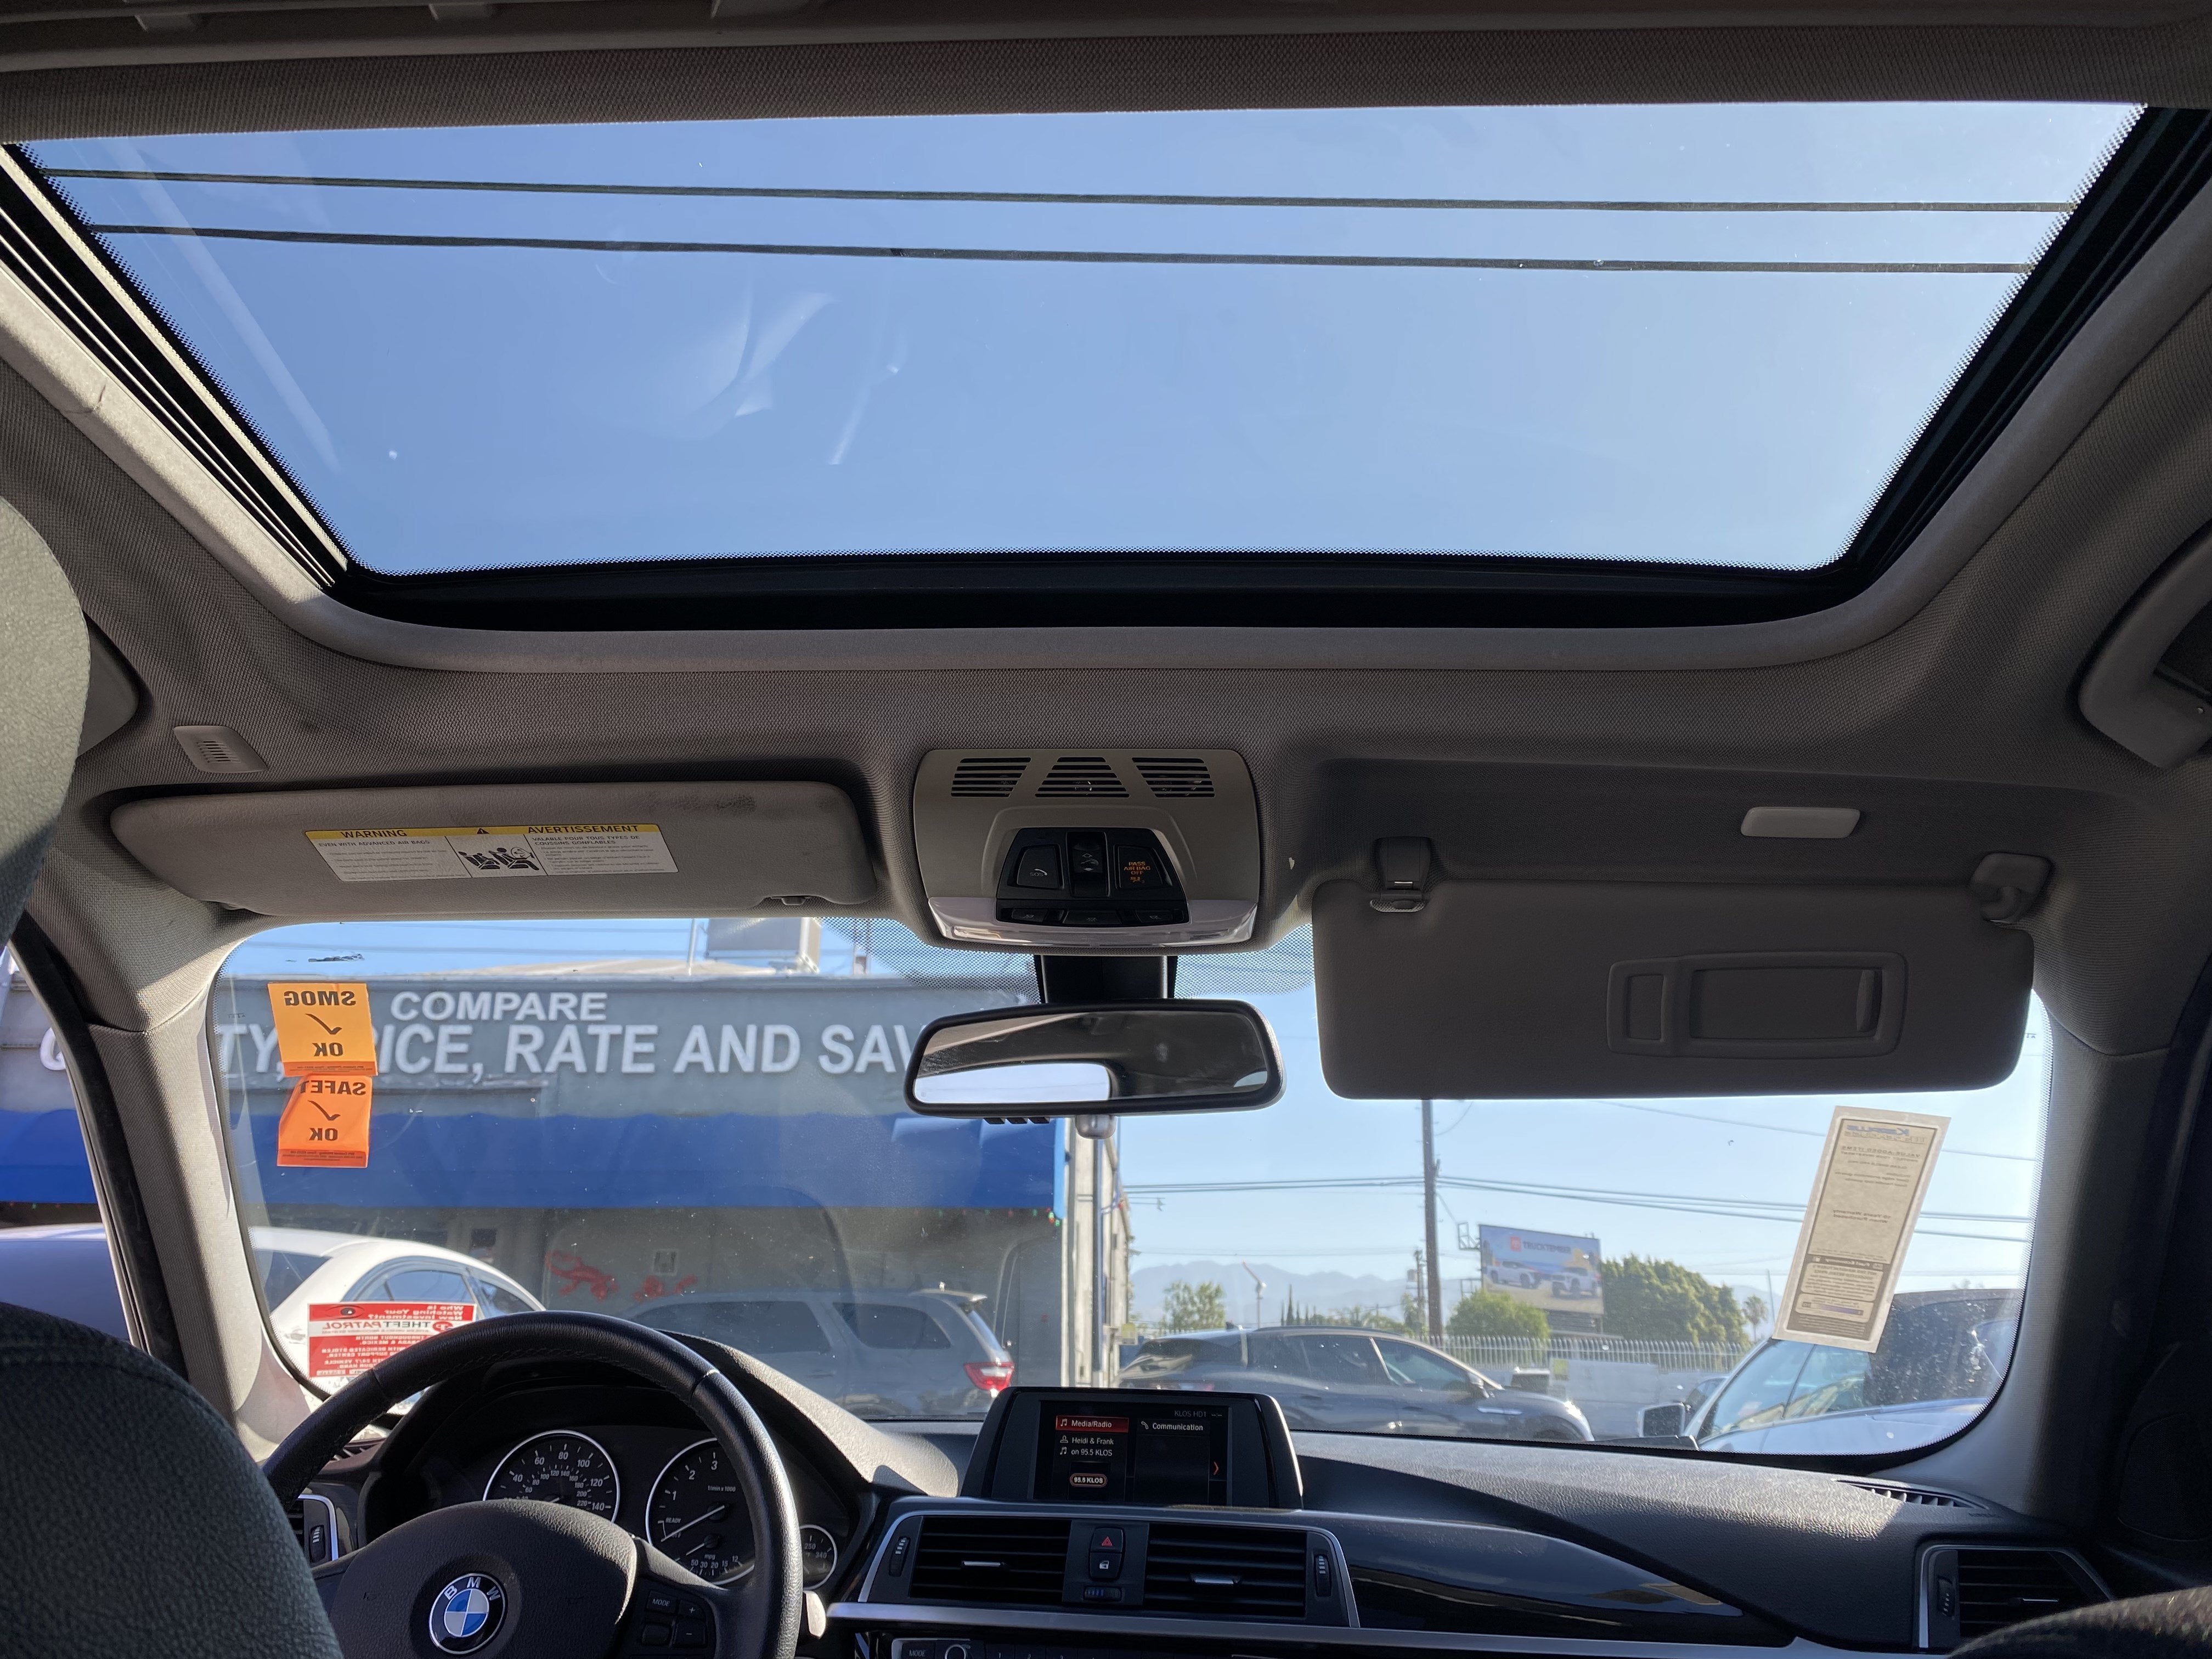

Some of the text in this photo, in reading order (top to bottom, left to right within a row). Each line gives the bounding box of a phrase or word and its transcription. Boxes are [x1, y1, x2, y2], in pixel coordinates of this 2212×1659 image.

[528, 825, 639, 833] AVERTISSEMENT
[341, 830, 407, 838] WARNING
[391, 991, 608, 1022] COMPARE
[503, 1024, 659, 1074] RATE
[673, 1024, 802, 1074] AND
[817, 1023, 927, 1075] SAV
[1152, 1423, 1203, 1431] Communication
[558, 1452, 569, 1460] 80
[534, 1457, 545, 1465] 60
[577, 1459, 590, 1468] 100
[711, 1460, 718, 1470] 3
[689, 1470, 696, 1480] 2
[590, 1479, 603, 1487] 120
[672, 1491, 677, 1500] 1
[592, 1502, 605, 1511] 140
[444, 1576, 501, 1601] BMW
[652, 1598, 672, 1607] MODE
[909, 1649, 927, 1657] MODE
